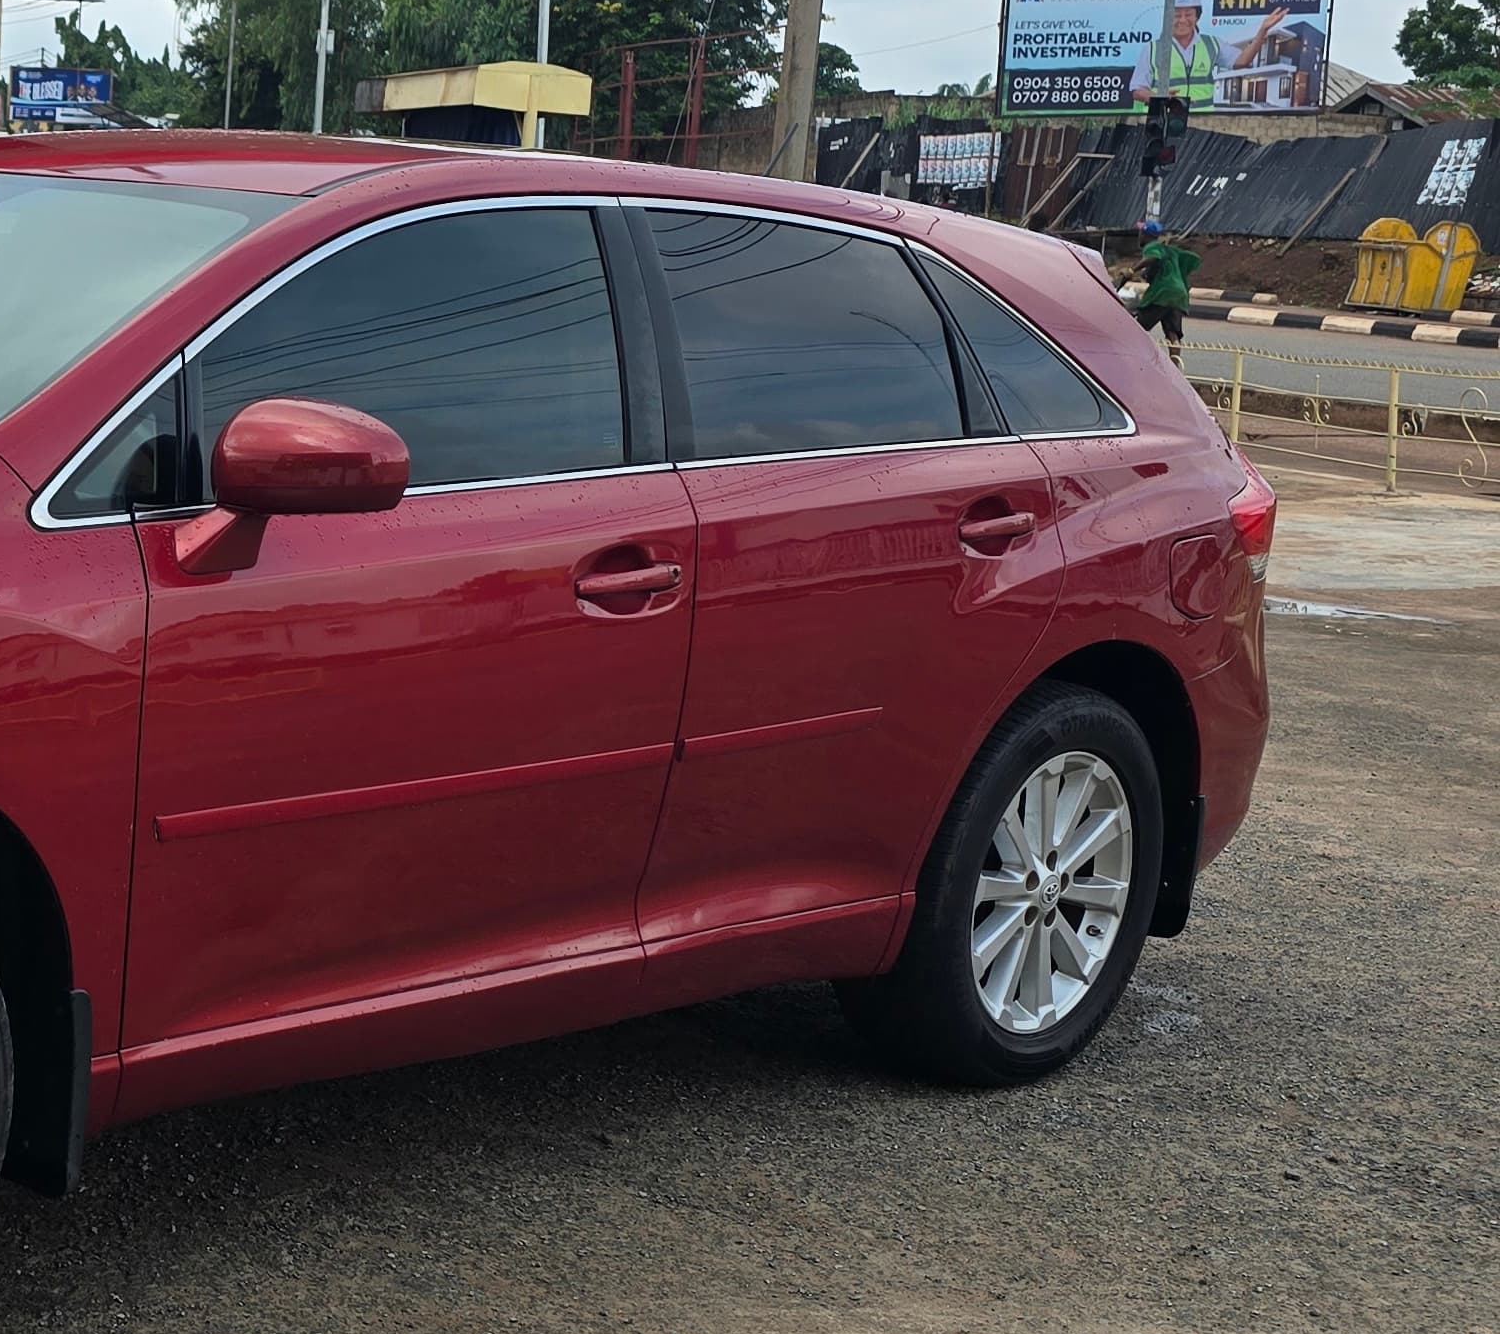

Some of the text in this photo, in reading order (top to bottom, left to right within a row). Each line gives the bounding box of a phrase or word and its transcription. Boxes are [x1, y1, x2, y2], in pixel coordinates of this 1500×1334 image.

[1041, 20, 1066, 29] GIVE
[1013, 31, 1153, 45] PROFITABLE LAND
[1012, 45, 1122, 59] INVESTMENTS
[1013, 75, 1125, 90] 0904 350 6500,
[1012, 89, 1120, 104] 0707 880 6088
